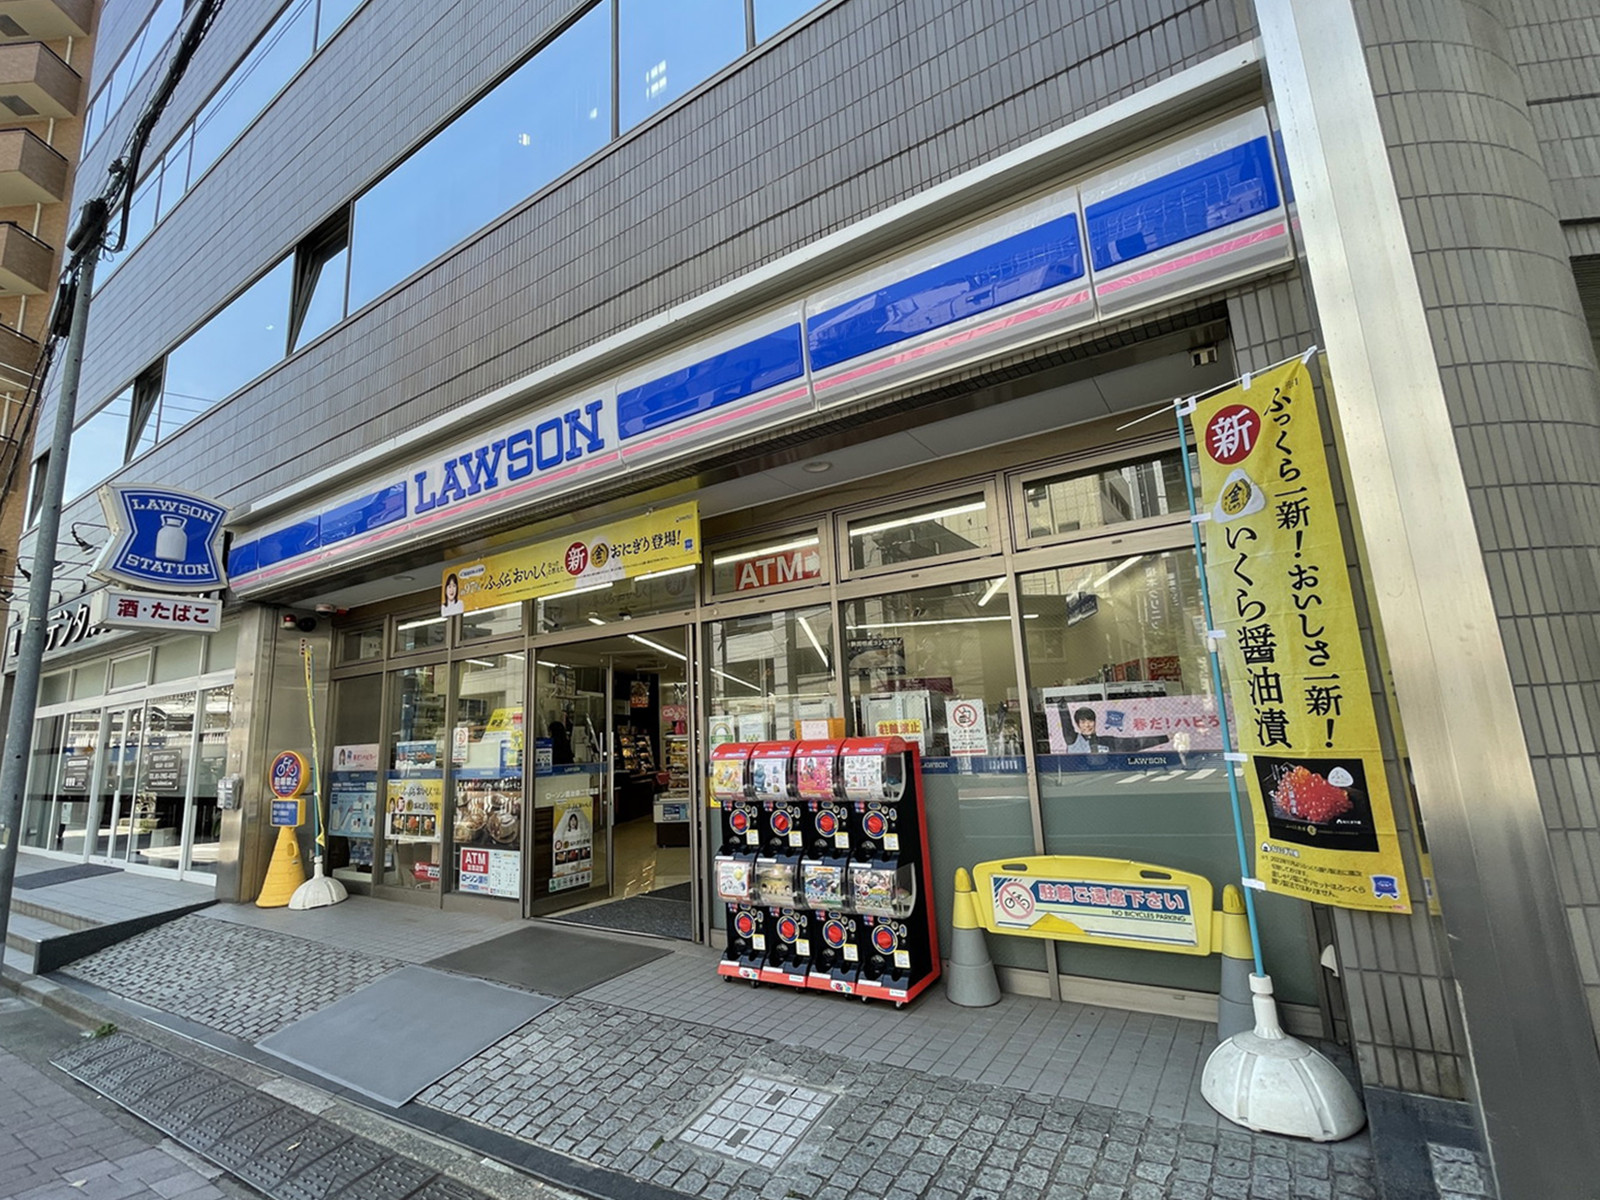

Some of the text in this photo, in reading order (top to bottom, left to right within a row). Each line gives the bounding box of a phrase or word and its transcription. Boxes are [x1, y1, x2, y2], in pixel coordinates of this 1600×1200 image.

[1211, 408, 1253, 459] 新
[414, 400, 605, 514] LAWSON
[1225, 482, 1243, 504] 金
[132, 498, 216, 523] LAWSON
[568, 544, 586, 572] 新
[610, 530, 681, 559] おにぎり登場!
[126, 553, 211, 576] STATION
[739, 552, 803, 590] ATM
[117, 599, 210, 625] 酒・たばこ
[1225, 526, 1293, 749] いくら醤油漬
[1127, 756, 1167, 765] LAWSON
[465, 852, 486, 865] ATM
[1038, 883, 1185, 911] 駐輪ご遠慮下さい
[1124, 911, 1155, 919] BICYCLES
[1156, 913, 1186, 922] PARKING
